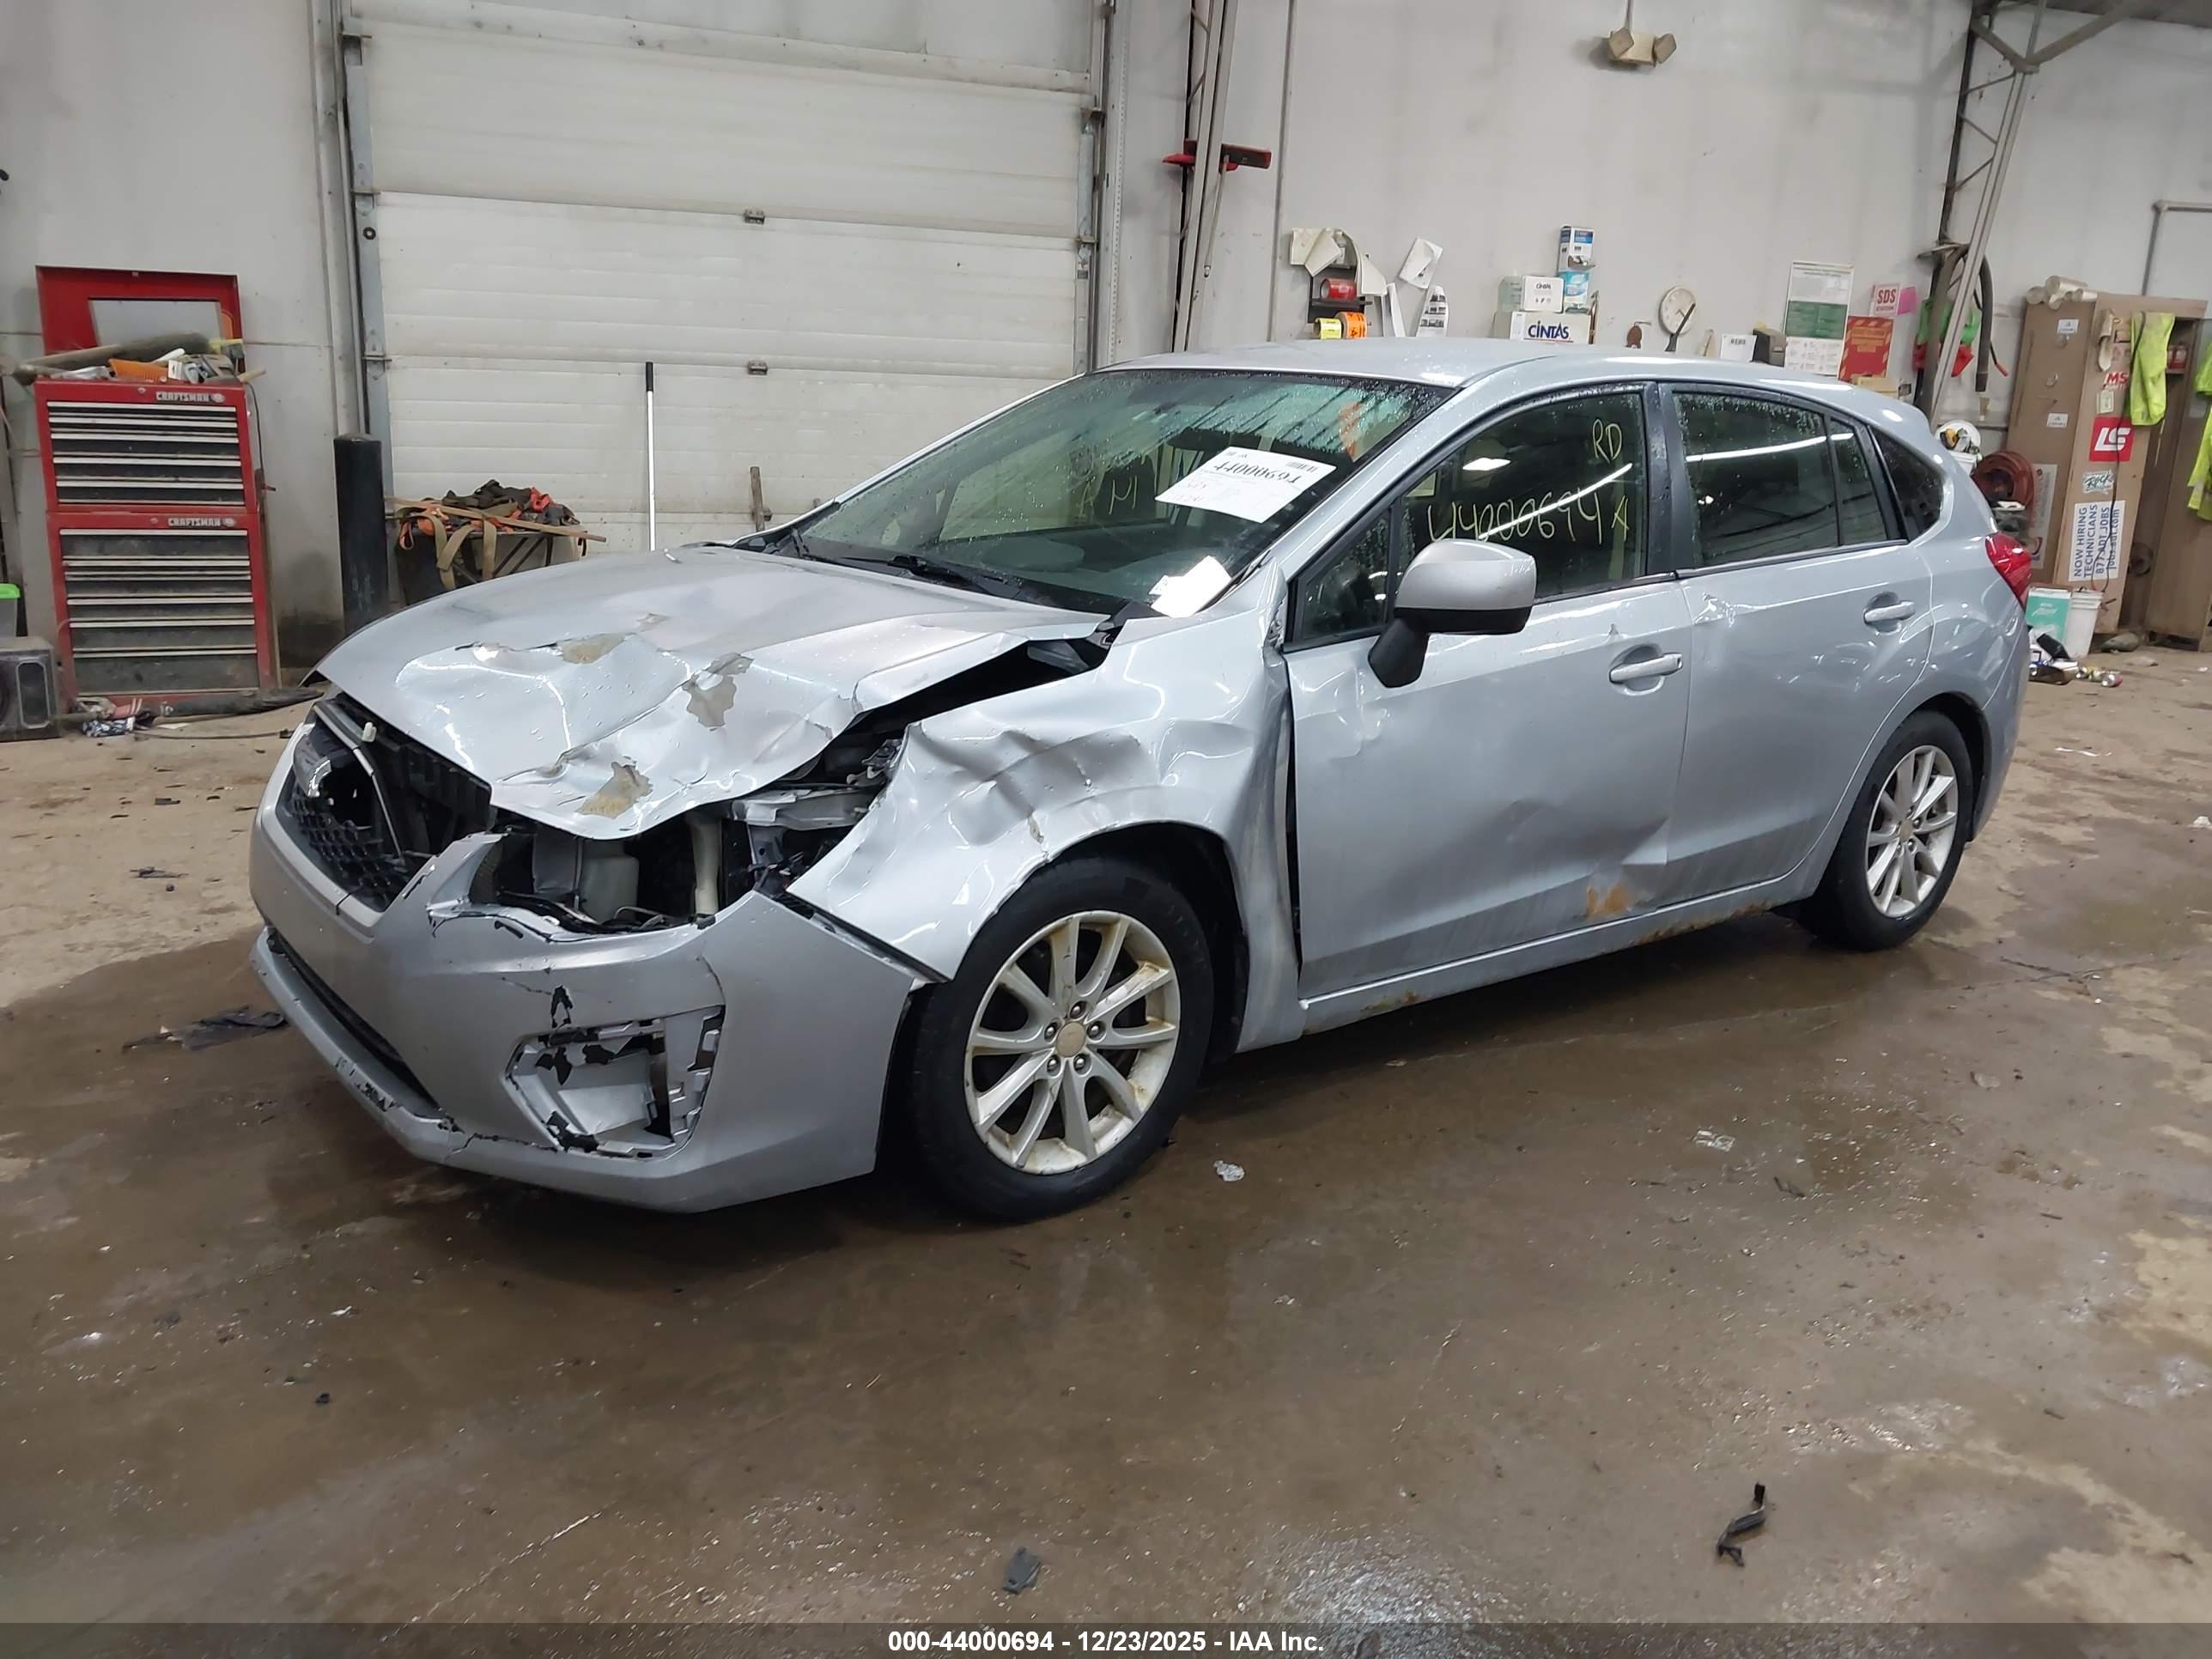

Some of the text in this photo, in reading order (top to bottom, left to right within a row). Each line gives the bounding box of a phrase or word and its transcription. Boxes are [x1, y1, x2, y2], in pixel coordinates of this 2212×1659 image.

[1877, 288, 1897, 305] SDS
[1528, 319, 1570, 339] CINTAS
[155, 391, 210, 403] CRAFTSMAN
[1592, 418, 1623, 464] RD
[167, 518, 221, 527] CRAFTSMAN
[1427, 486, 1602, 544] 44000694
[2074, 507, 2087, 577] NOW HIRING
[2083, 504, 2098, 578] TECHNICIANS
